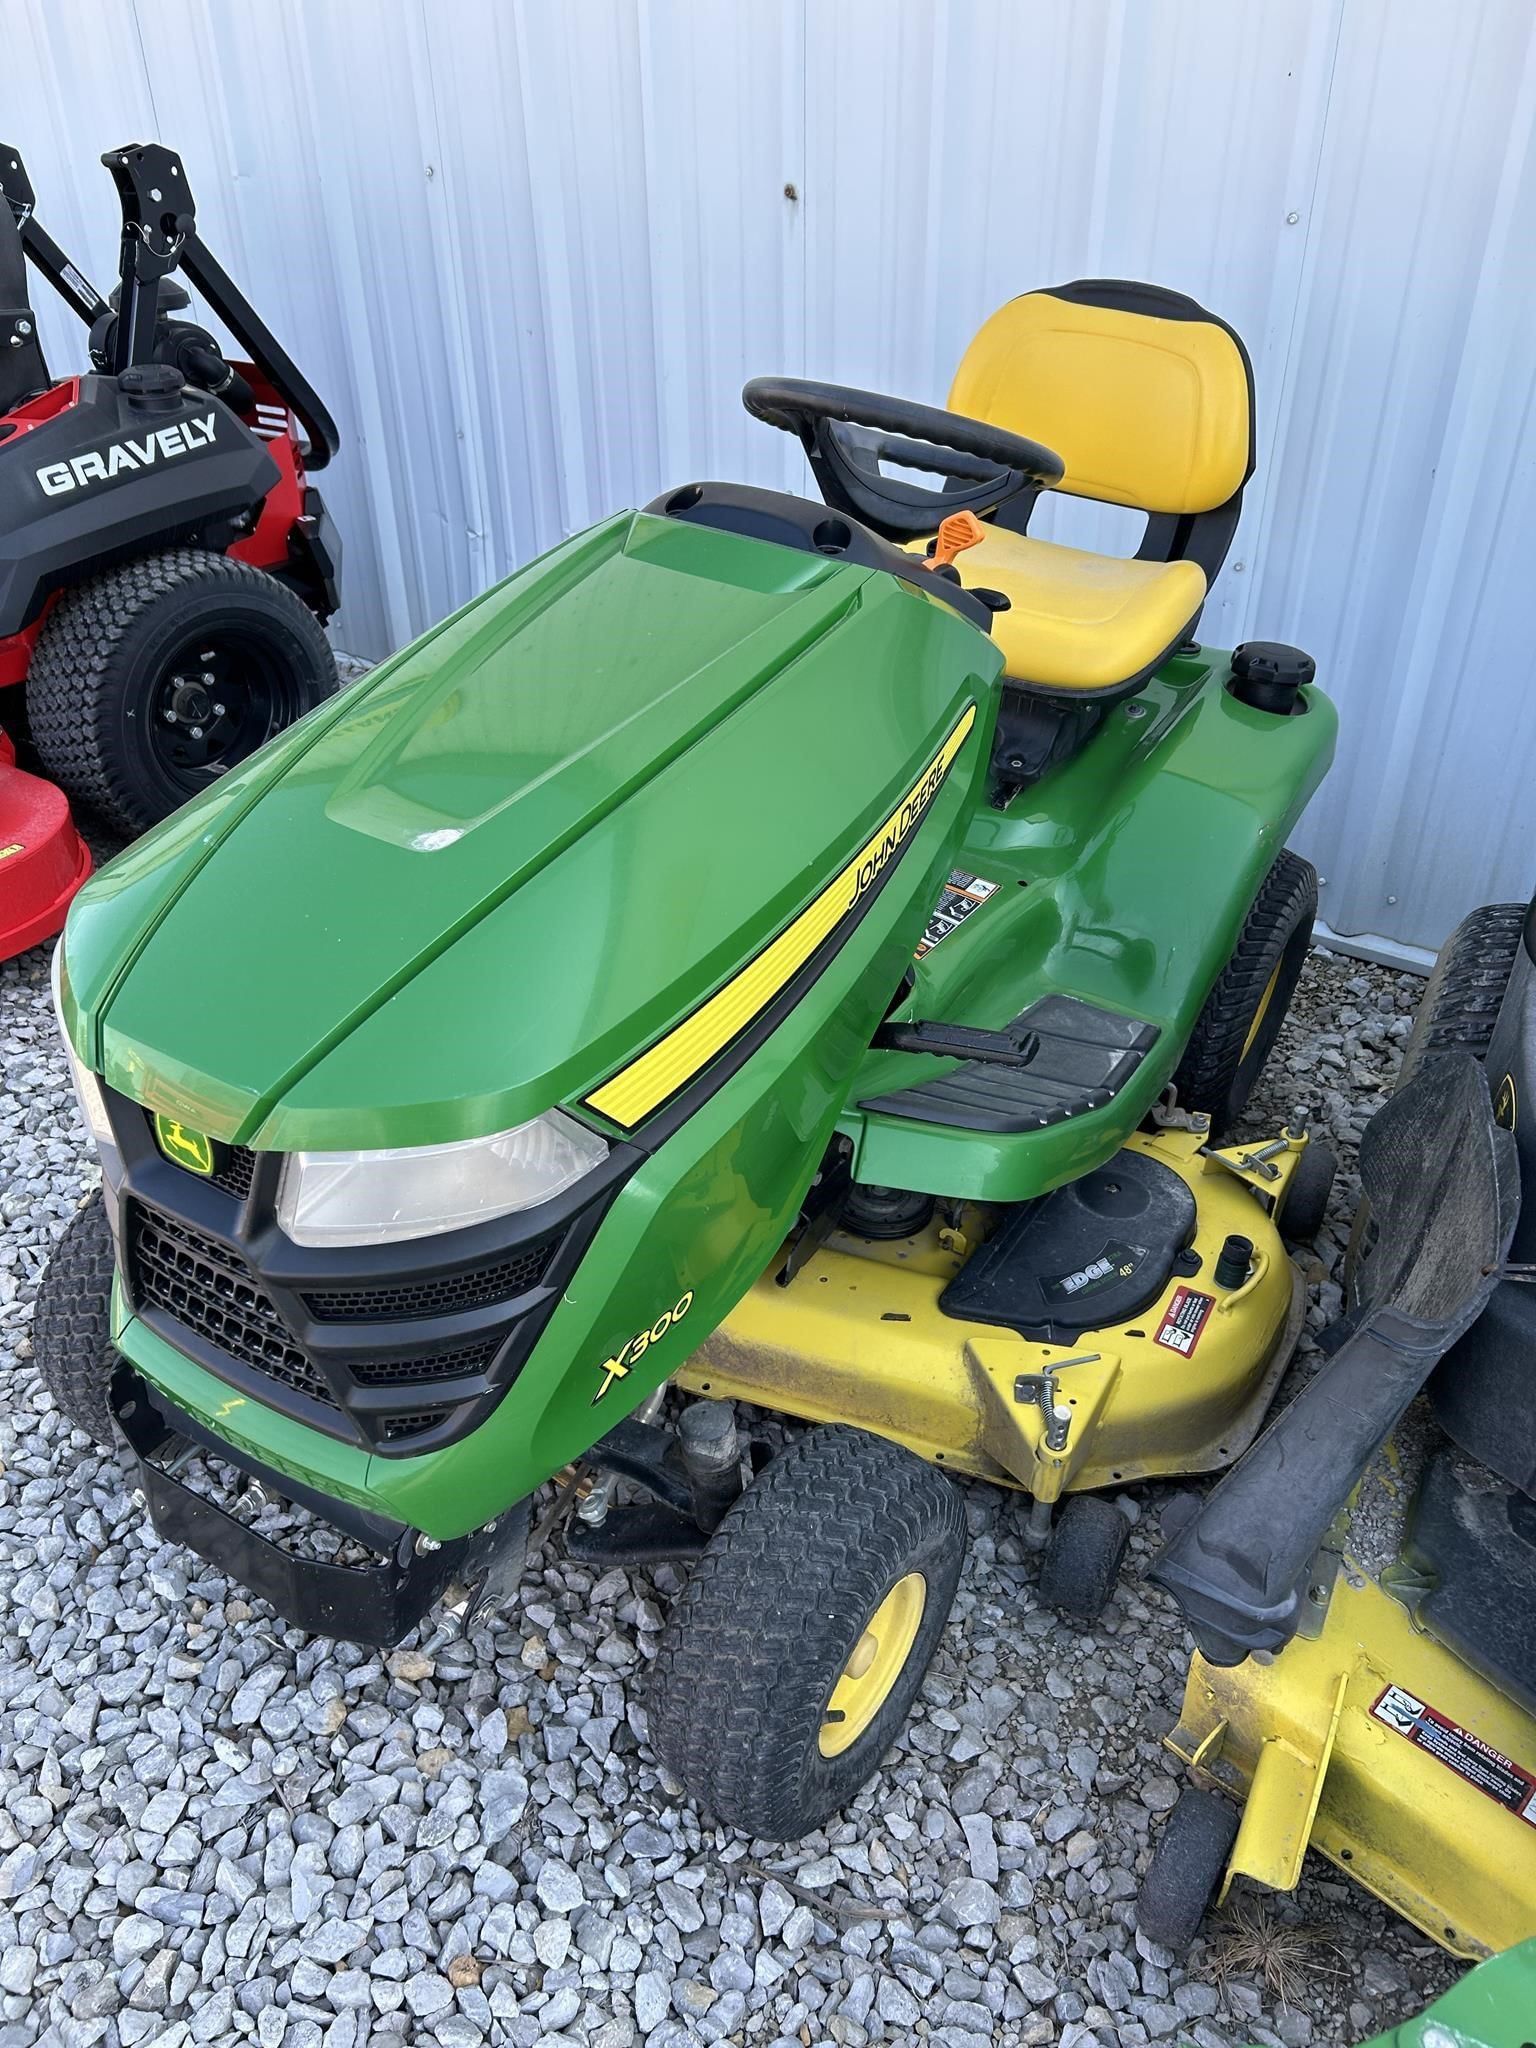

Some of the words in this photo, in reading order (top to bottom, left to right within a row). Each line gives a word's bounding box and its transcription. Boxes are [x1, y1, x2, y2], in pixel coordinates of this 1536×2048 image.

[36, 412, 216, 496] GRAVELY
[849, 826, 897, 909] JOHN
[899, 754, 945, 843] DEERE
[1059, 1257, 1114, 1295] EDGE
[1169, 1294, 1182, 1313] DANGER
[592, 1289, 694, 1406] X300
[1463, 1732, 1513, 1769] DANGER
